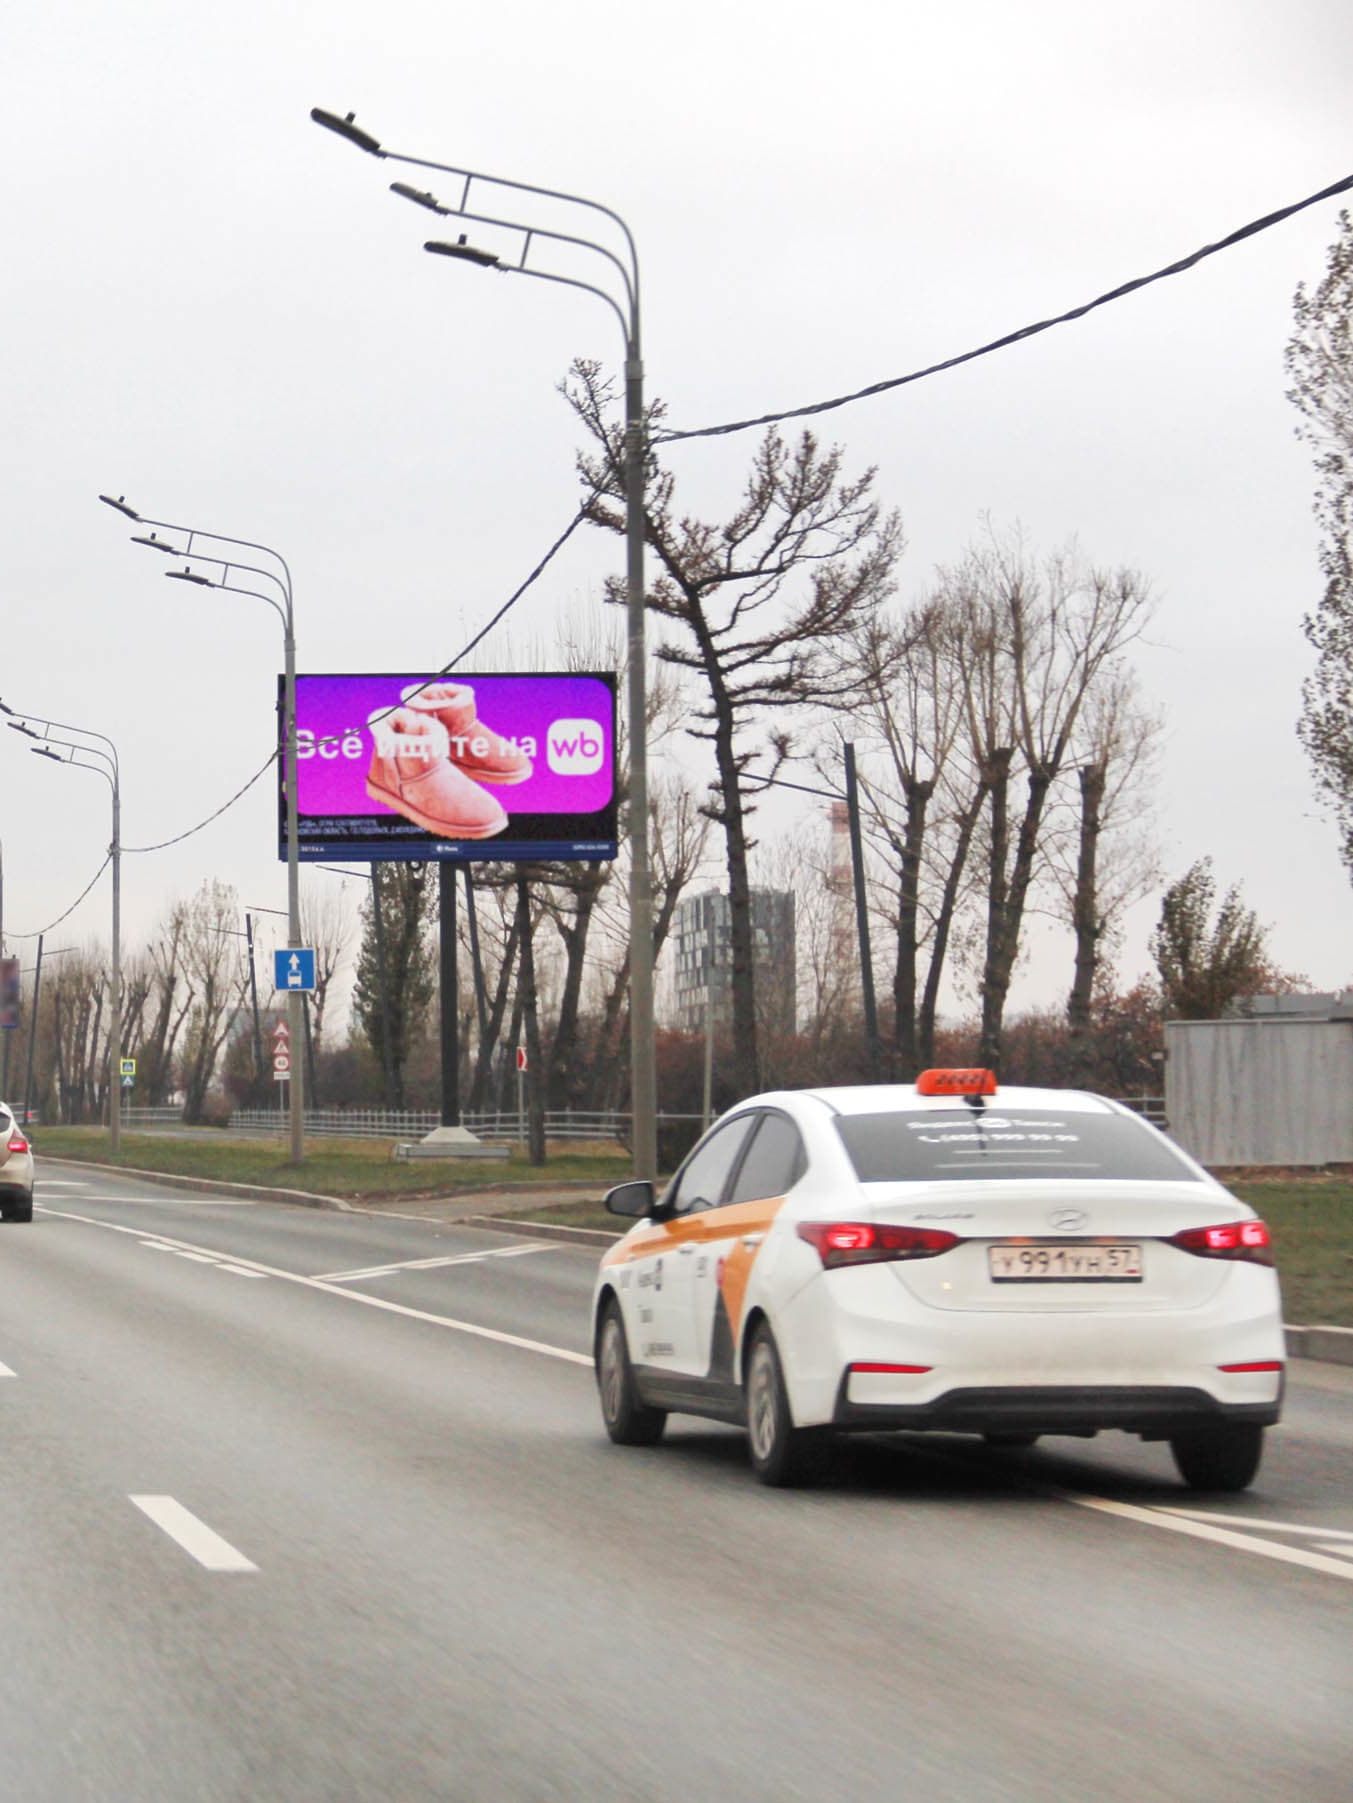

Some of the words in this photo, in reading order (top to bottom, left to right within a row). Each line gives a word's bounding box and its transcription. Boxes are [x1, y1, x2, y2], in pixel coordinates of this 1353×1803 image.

[296, 728, 364, 760] Всё
[500, 734, 538, 758] на
[551, 730, 600, 759] wb
